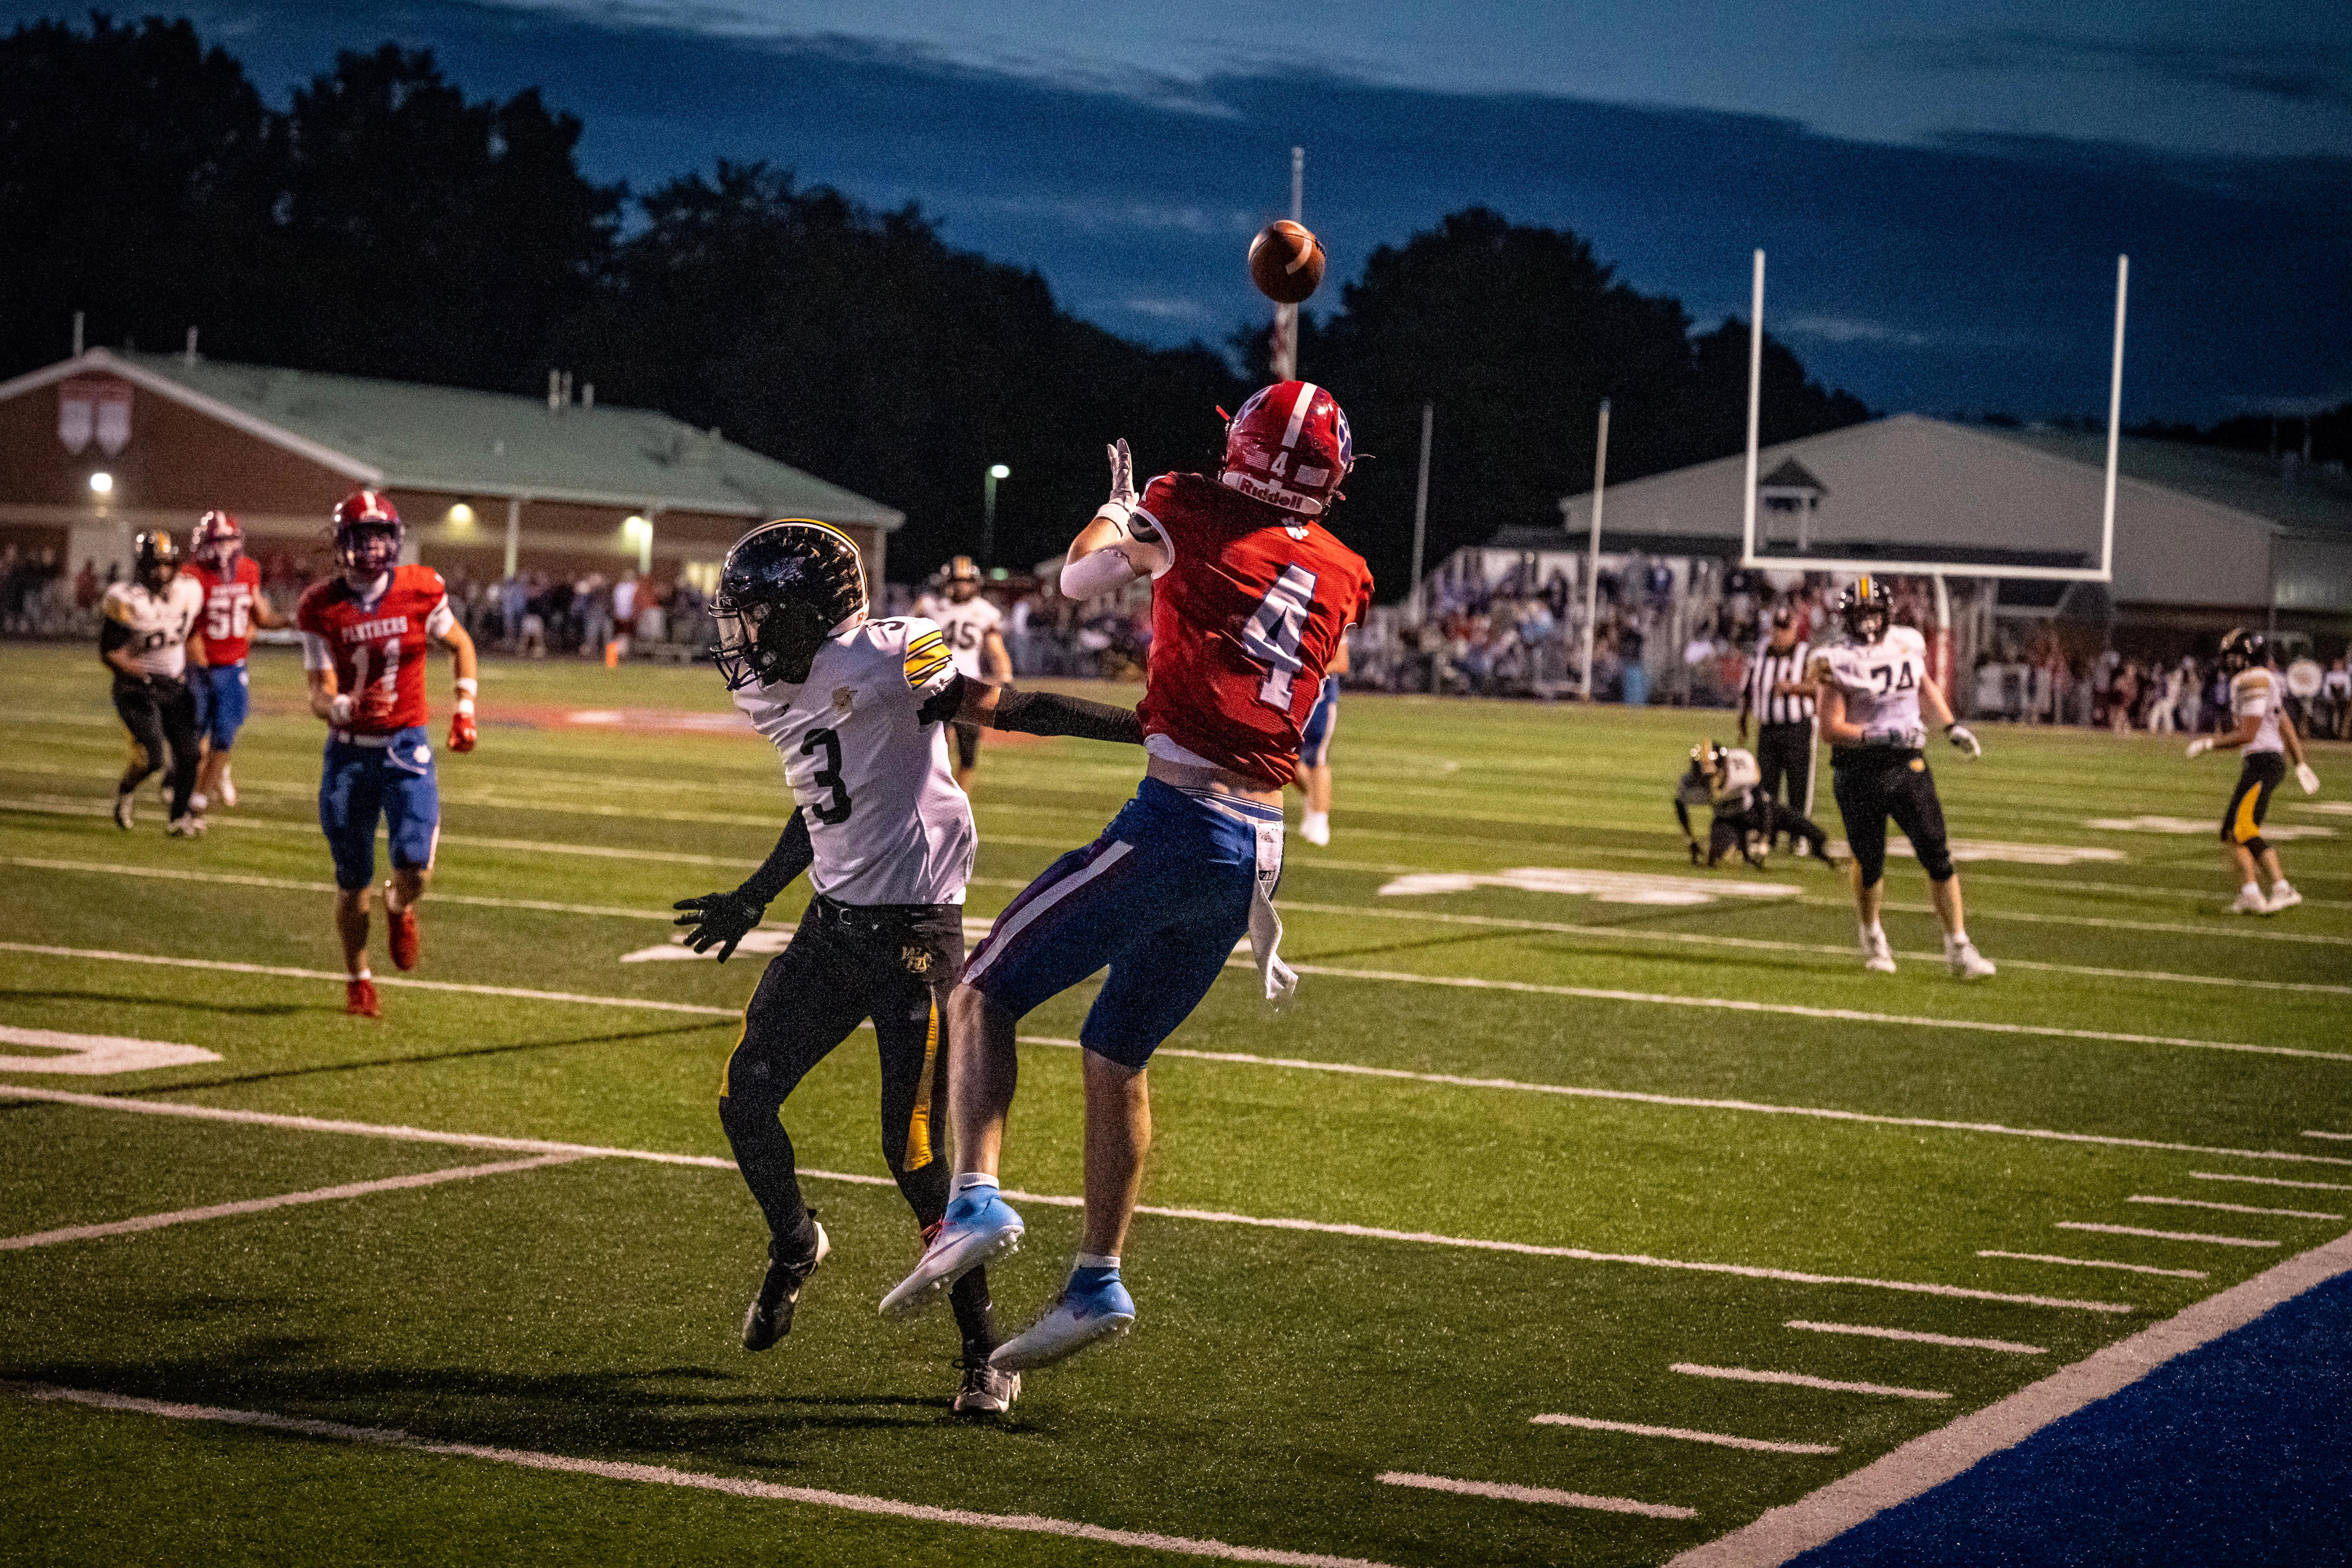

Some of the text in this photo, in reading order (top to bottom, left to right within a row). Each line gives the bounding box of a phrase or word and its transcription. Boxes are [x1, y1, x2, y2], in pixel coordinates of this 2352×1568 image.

[1270, 451, 1288, 476] 4
[1239, 478, 1303, 509] Riddell
[941, 619, 976, 650] 45
[1243, 561, 1318, 715] 4
[350, 637, 400, 718] 11
[1870, 662, 1914, 697] 74
[800, 728, 852, 825] 3
